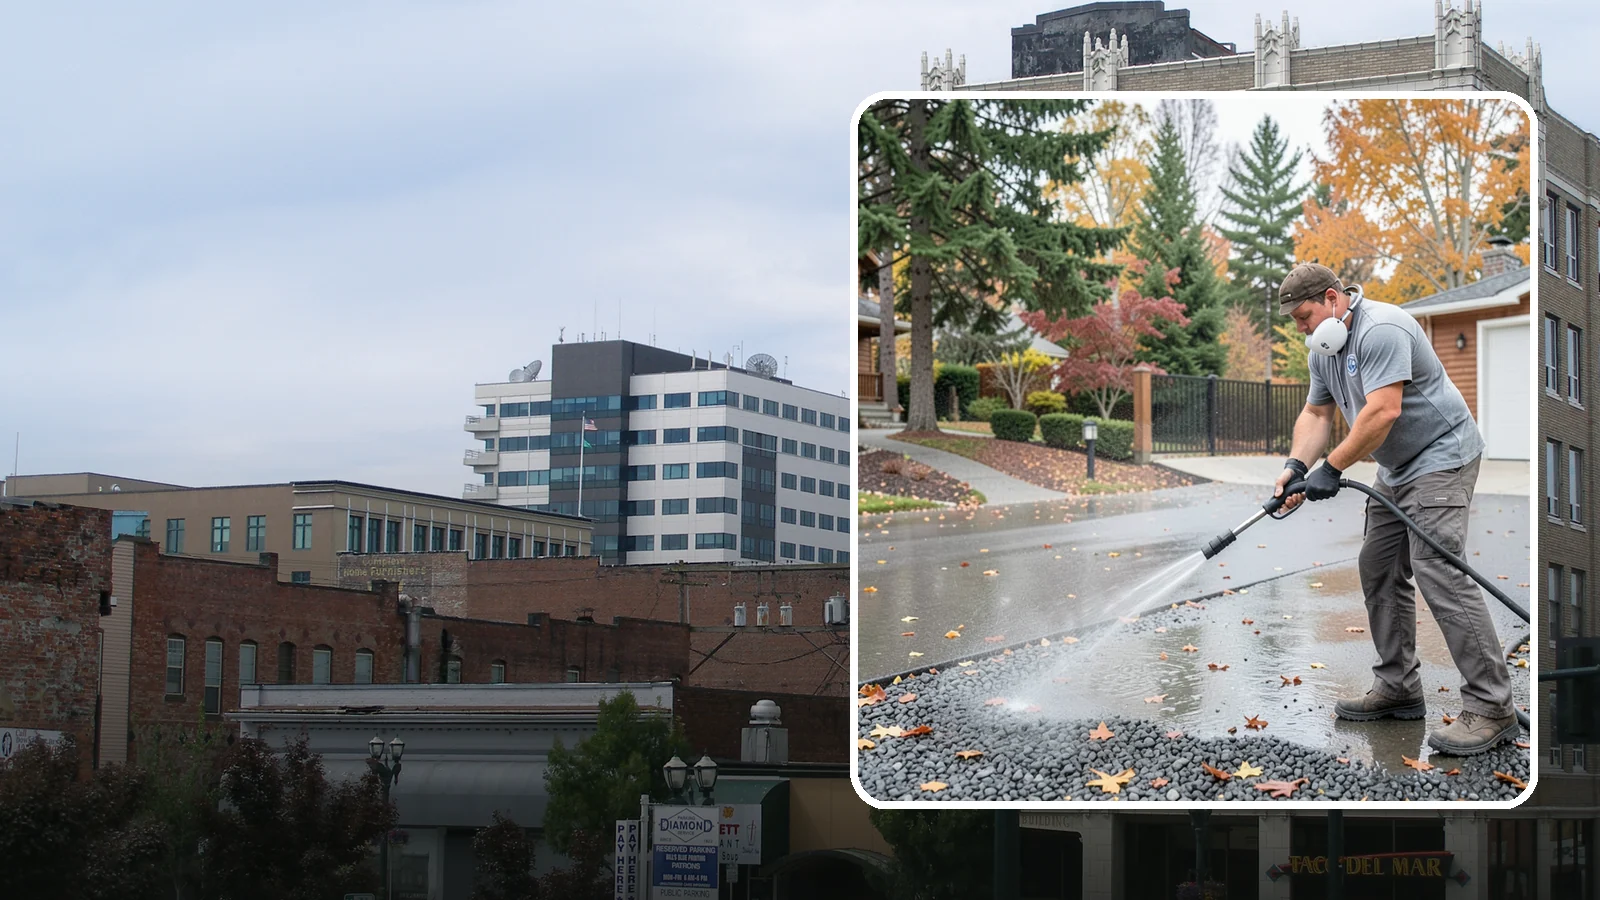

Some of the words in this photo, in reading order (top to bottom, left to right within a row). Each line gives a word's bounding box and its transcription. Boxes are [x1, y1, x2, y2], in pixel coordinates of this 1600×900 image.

[343, 568, 368, 577] Home
[370, 566, 427, 576] Furnishers
[660, 818, 713, 833] DIAMOND
[1021, 815, 1069, 828] BUILDING
[617, 825, 625, 852] PAY
[628, 824, 637, 852] PAY
[655, 845, 688, 853] RESERVED
[689, 846, 716, 854] PARKING
[722, 851, 739, 862] Soup
[671, 862, 701, 870] PATRONS
[1346, 856, 1385, 876] DEL
[1391, 857, 1443, 877] MAR
[616, 856, 625, 894] HERE
[627, 855, 636, 893] HERE
[660, 888, 682, 897] PUBLIC
[683, 889, 710, 898] PARKING
